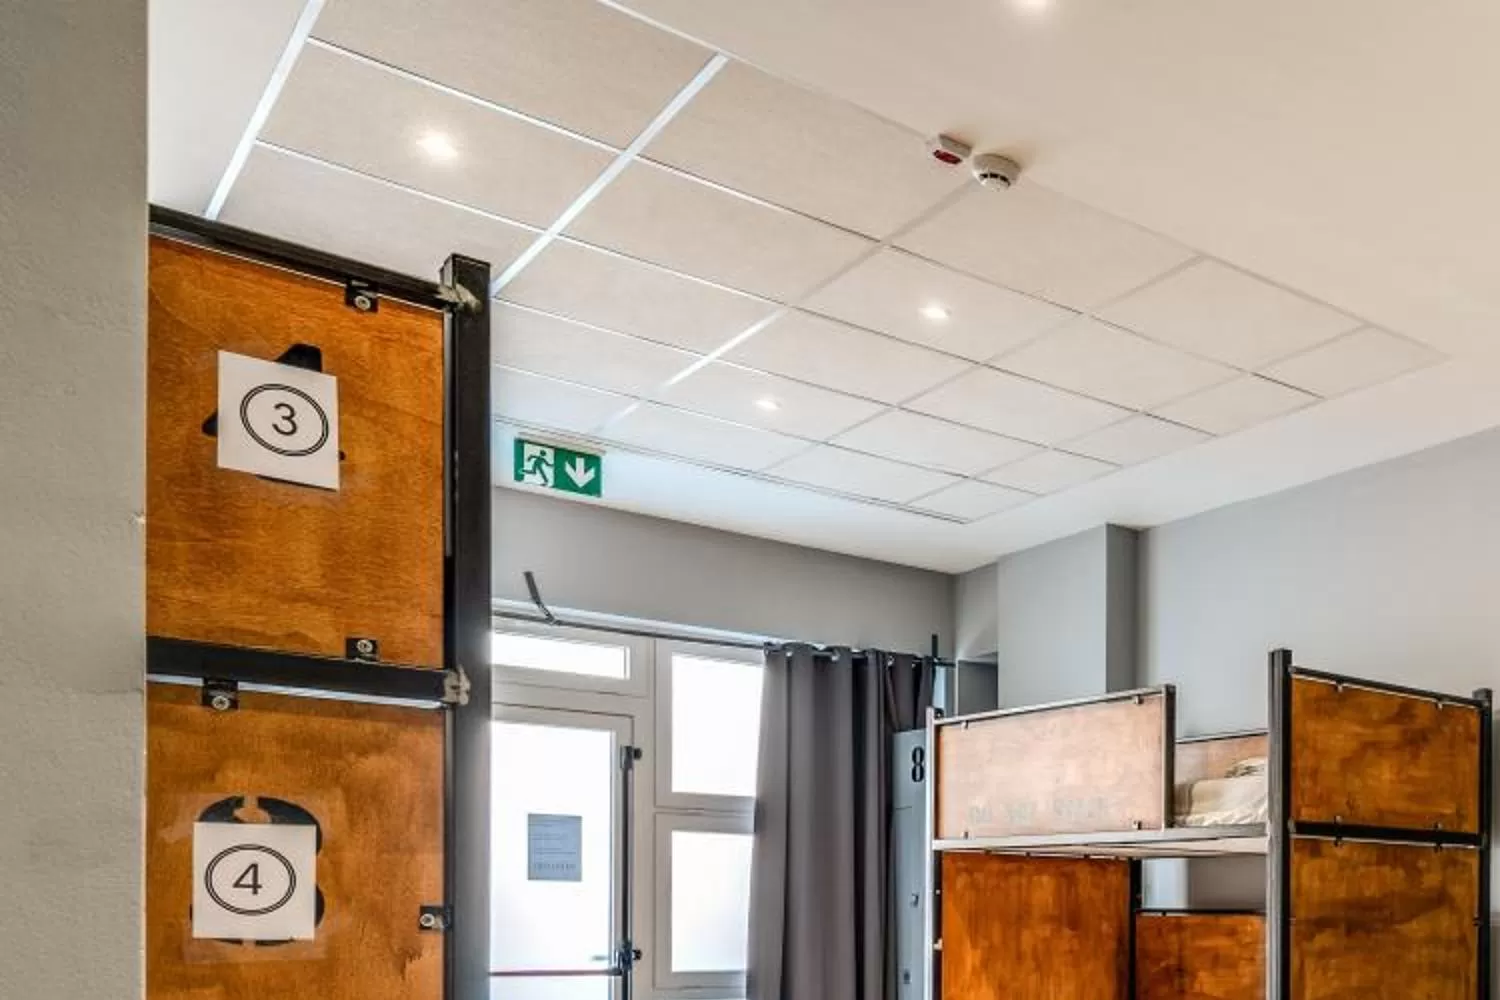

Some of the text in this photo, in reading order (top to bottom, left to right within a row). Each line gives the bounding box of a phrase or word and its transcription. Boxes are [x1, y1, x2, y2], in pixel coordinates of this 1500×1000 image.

[272, 402, 298, 436] 3
[912, 747, 925, 782] 8
[233, 862, 263, 895] 4
